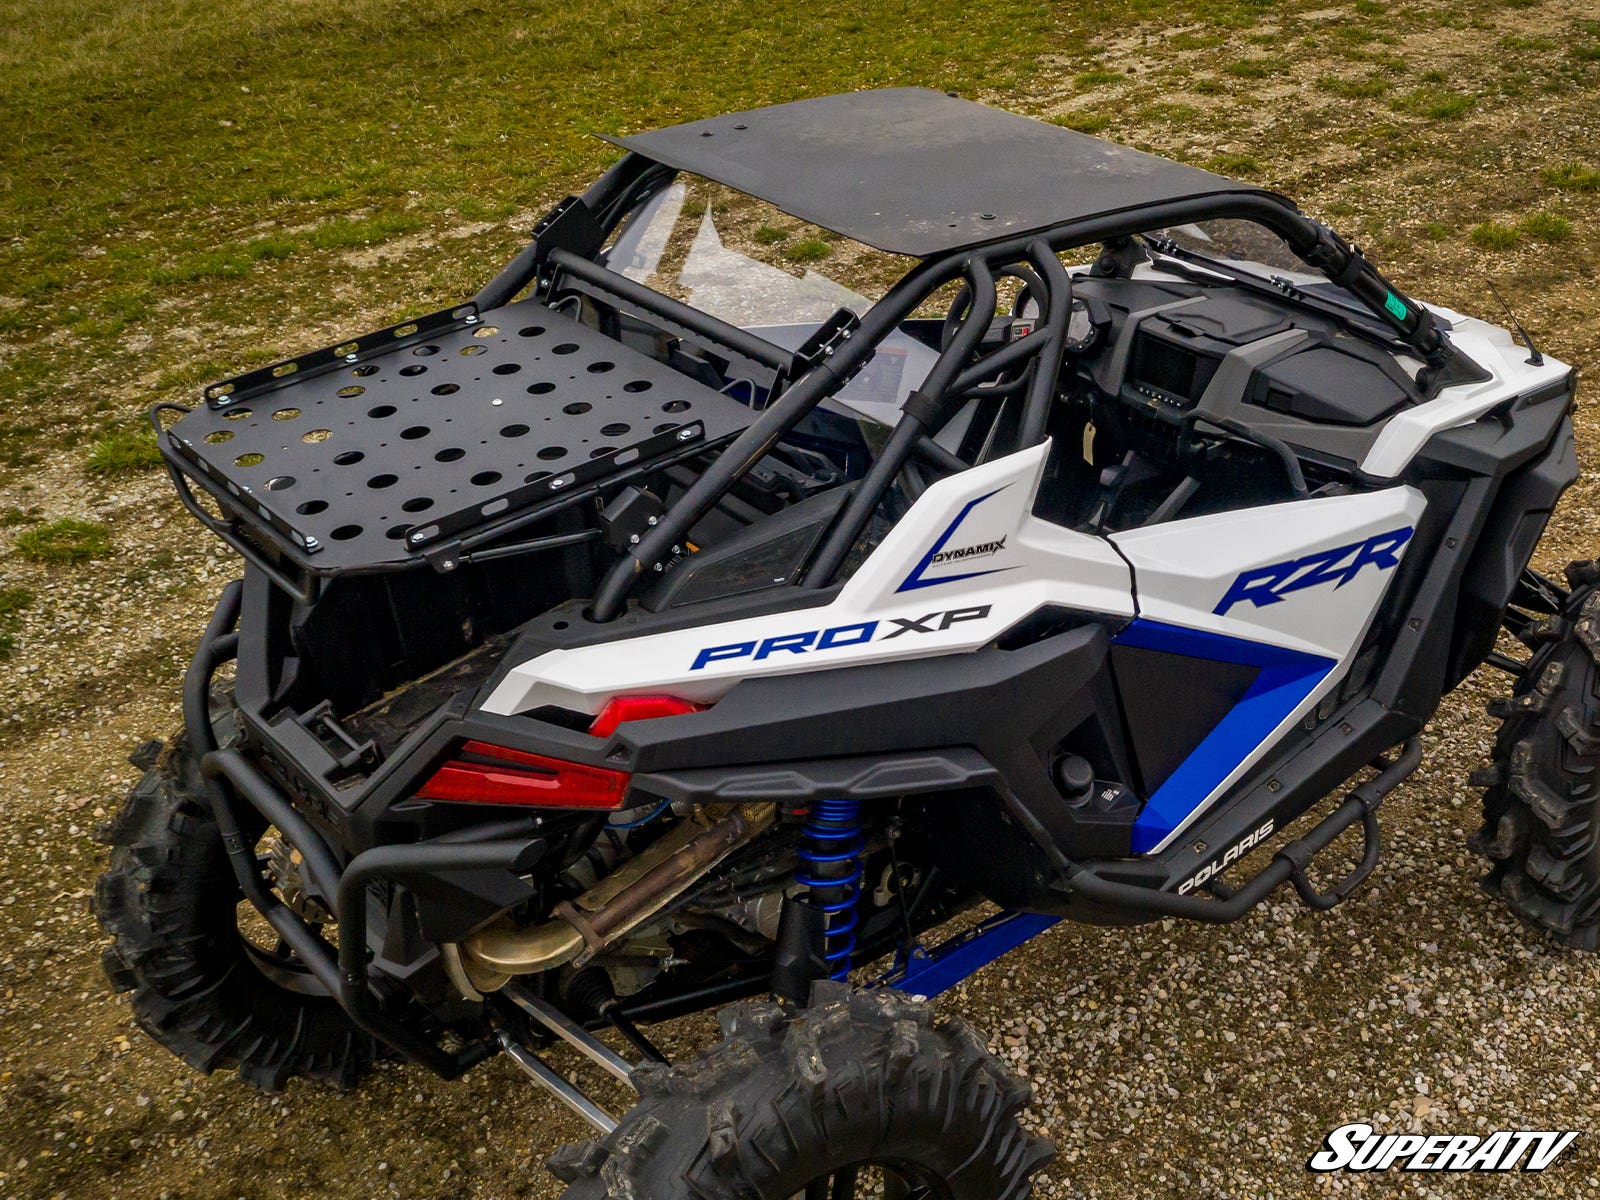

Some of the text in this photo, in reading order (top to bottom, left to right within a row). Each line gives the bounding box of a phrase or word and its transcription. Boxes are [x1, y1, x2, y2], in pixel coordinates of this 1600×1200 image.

[932, 534, 1007, 563] DYNAMIX
[1211, 525, 1414, 616] RZR
[688, 604, 993, 672] PRO XP
[1177, 818, 1275, 896] POLARIS
